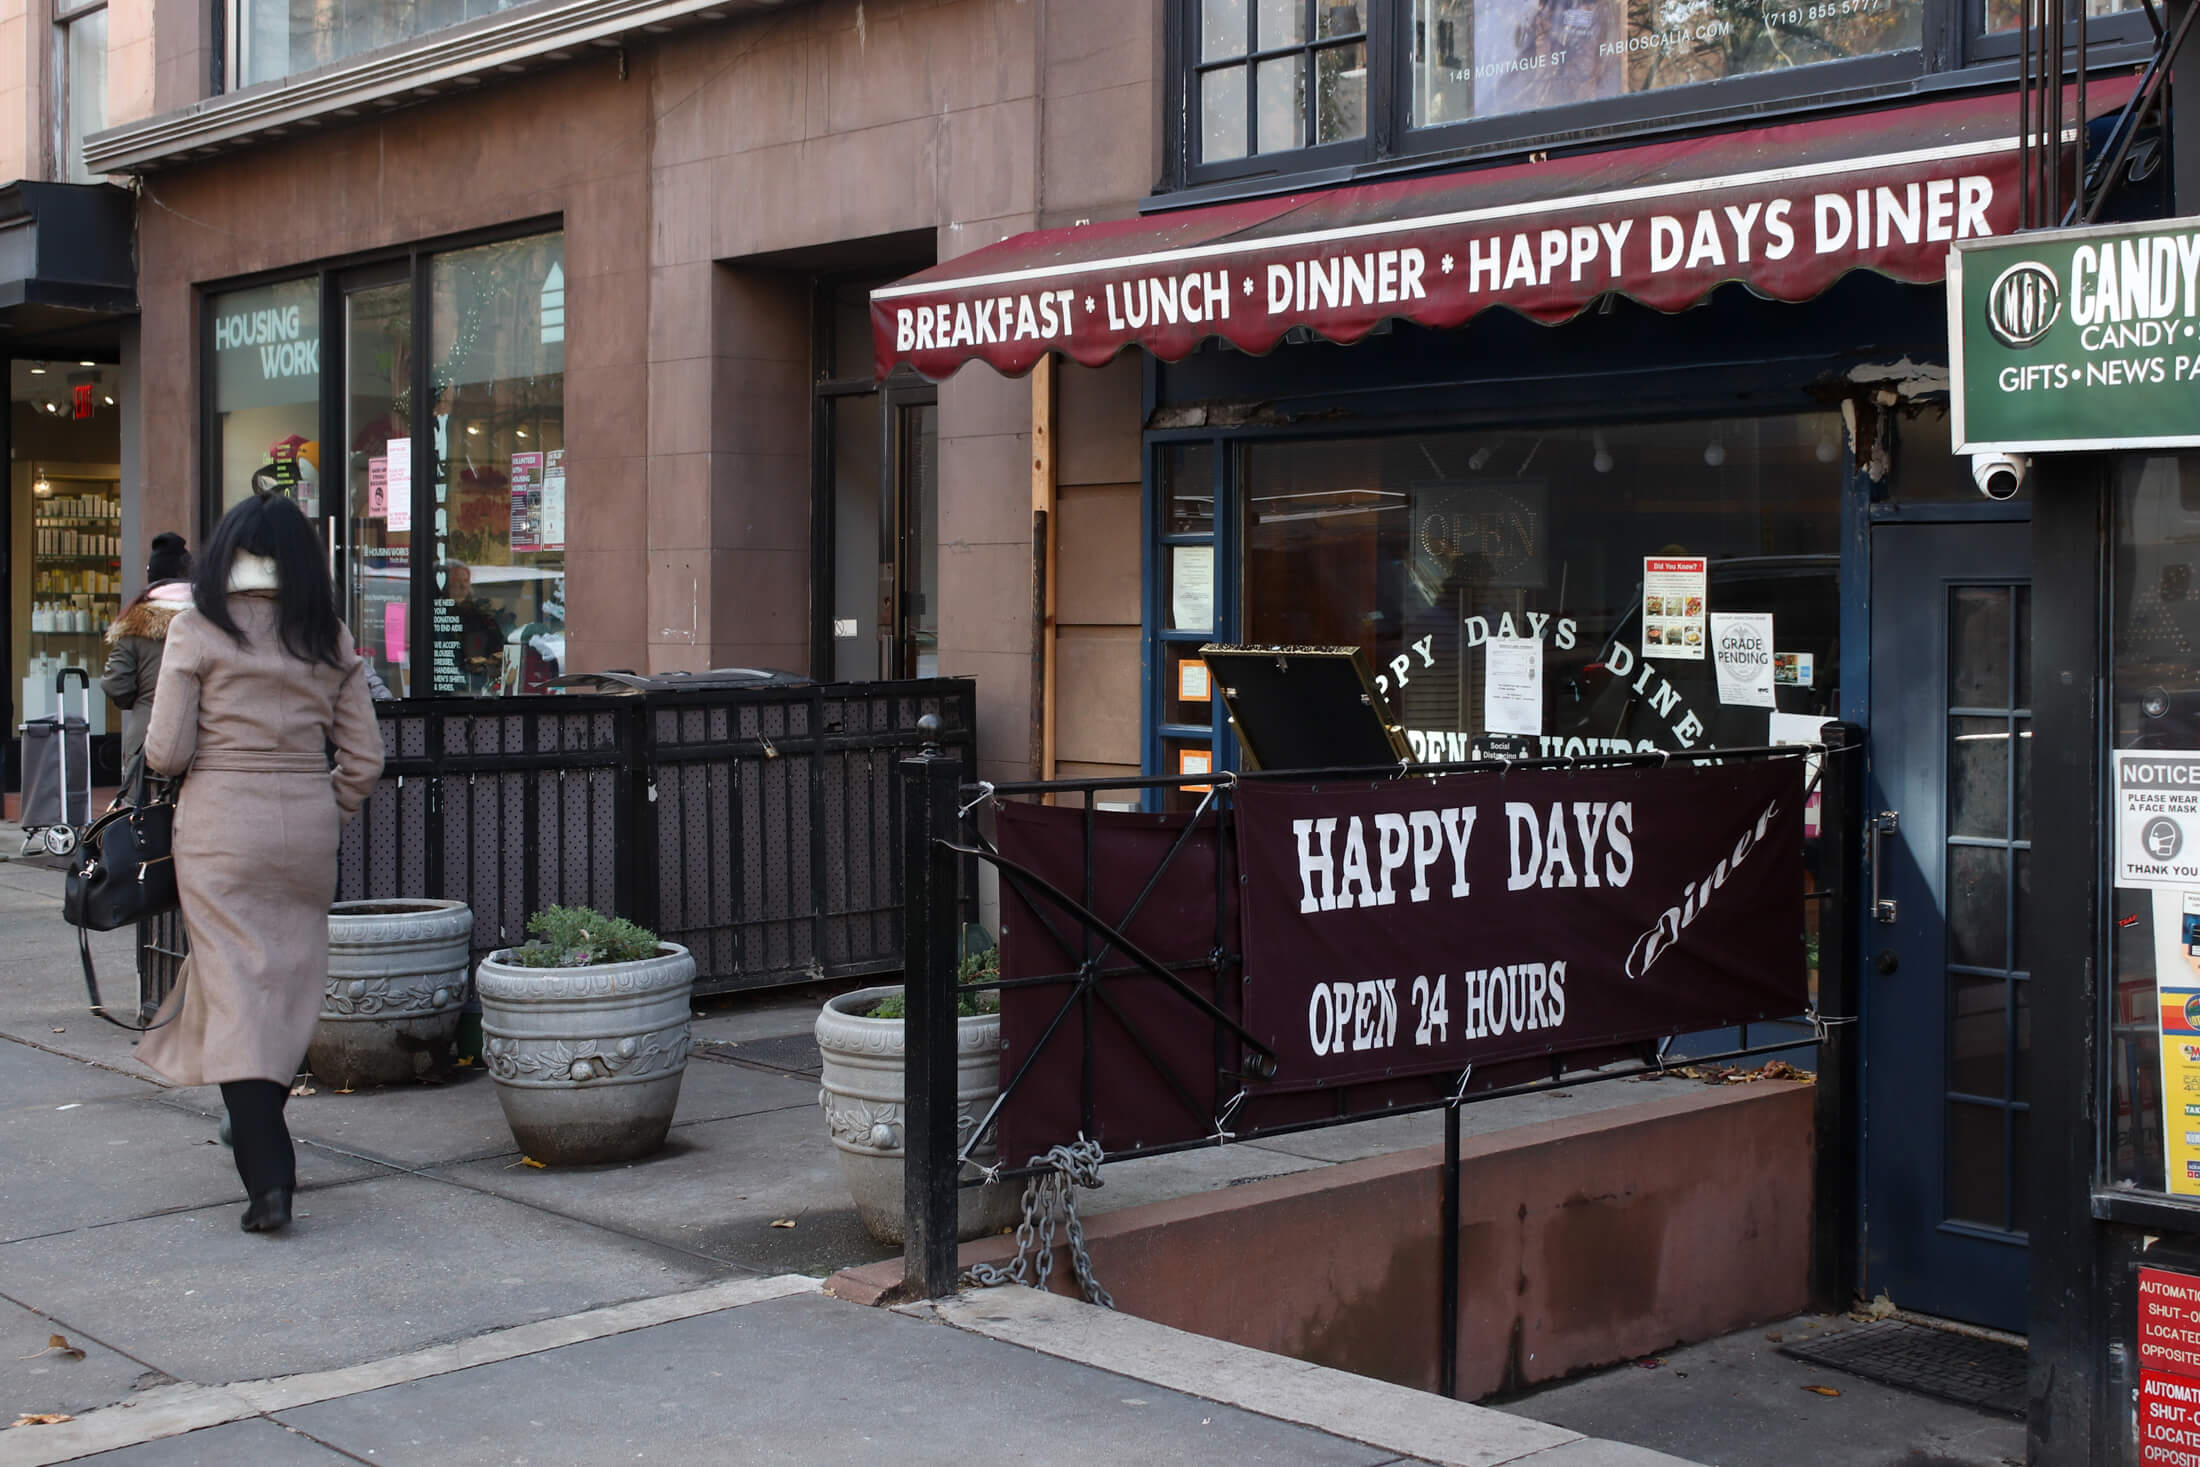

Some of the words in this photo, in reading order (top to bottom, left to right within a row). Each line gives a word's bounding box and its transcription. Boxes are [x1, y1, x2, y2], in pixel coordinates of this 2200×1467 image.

[1764, 8, 1803, 28] (718)
[1808, 3, 1836, 20] 855
[1599, 22, 1731, 58] FABIOSCALIA.COM
[1449, 70, 1471, 83] 148
[1475, 55, 1547, 79] MONTAGUE
[1551, 51, 1567, 65] ST
[896, 289, 1076, 353] BREAKFAST
[1105, 270, 1230, 331] LUNCH
[1266, 247, 1426, 314] DINNER
[1469, 219, 1633, 294] HAPPY
[1650, 198, 1795, 274] DAYS
[1813, 175, 1994, 255] DINER
[2070, 233, 2200, 327] CANDY
[215, 304, 299, 351] HOUSING
[2080, 319, 2180, 351] CANDY
[260, 338, 319, 380] WORK
[1999, 363, 2069, 392] GIFTS
[2086, 356, 2166, 387] NEWS
[1464, 611, 1577, 650] DAYS
[1722, 637, 1762, 650] GRADE
[1718, 651, 1769, 664] PENDING
[1406, 730, 1468, 765] PEN
[1483, 751, 1517, 760] Distcin
[1490, 741, 1510, 750] Social
[2123, 764, 2200, 784] NOTICE
[2128, 794, 2167, 803] PLEASE
[2169, 795, 2198, 804] WEAR
[2139, 804, 2165, 812] FACE
[2168, 805, 2197, 813] MASK
[1293, 805, 1477, 914] HAPPY
[1505, 801, 1634, 891] DAYS
[2127, 864, 2168, 875] THANK
[2173, 866, 2198, 876] YOU
[1625, 799, 1779, 979] Diner
[1309, 977, 1398, 1057] OPEN
[1411, 973, 1449, 1047] 24
[1465, 960, 1566, 1040] HOURS
[2148, 1302, 2200, 1323] SHUT-O
[2141, 1343, 2200, 1367] OPPOSITE
[2144, 1445, 2200, 1467] OPPOSIT
